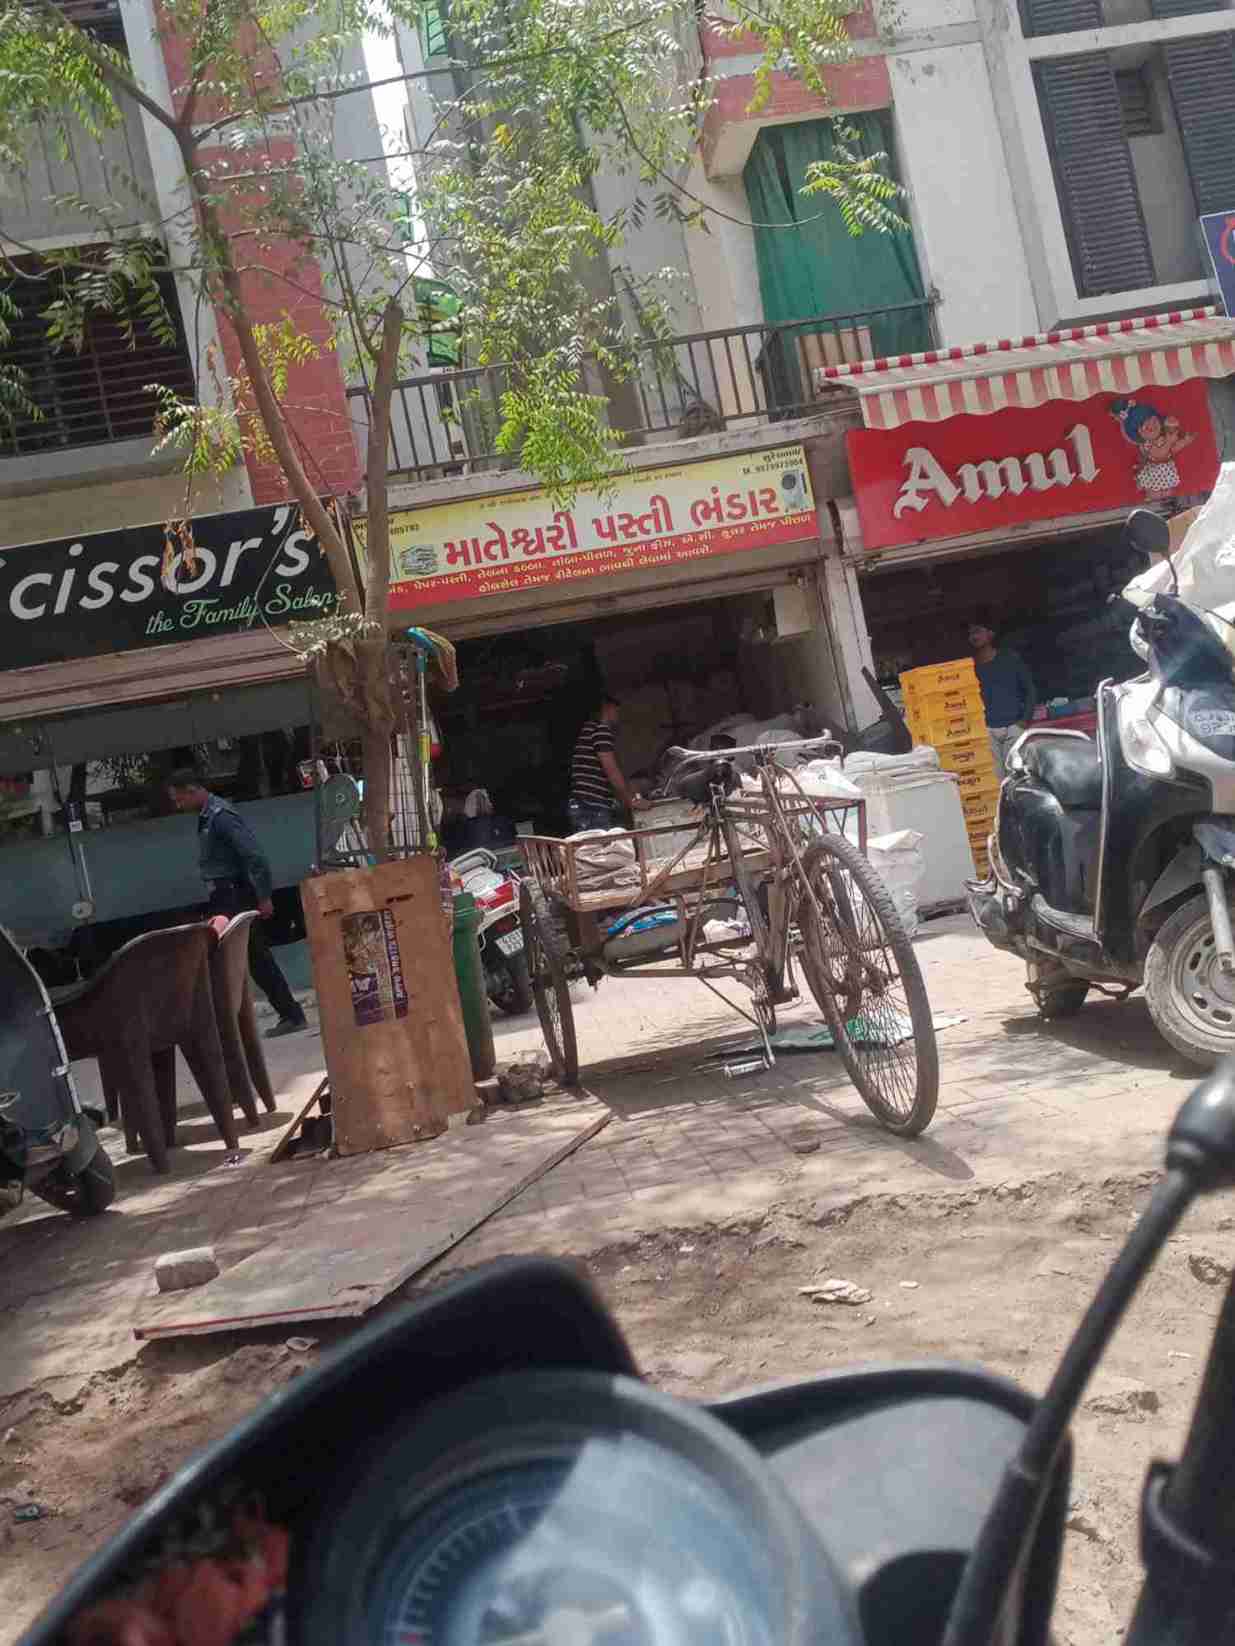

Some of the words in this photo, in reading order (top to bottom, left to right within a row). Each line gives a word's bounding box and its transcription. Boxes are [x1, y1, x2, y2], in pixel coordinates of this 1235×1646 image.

[894, 423, 1101, 519] Amul
[0, 506, 313, 620] cissor's
[443, 512, 578, 566] માતેશ્વરી
[592, 494, 674, 541] પસ્તી
[690, 486, 780, 528] ભંડાર
[146, 611, 175, 634] the
[181, 595, 257, 627] Family
[265, 583, 334, 614] Salon
